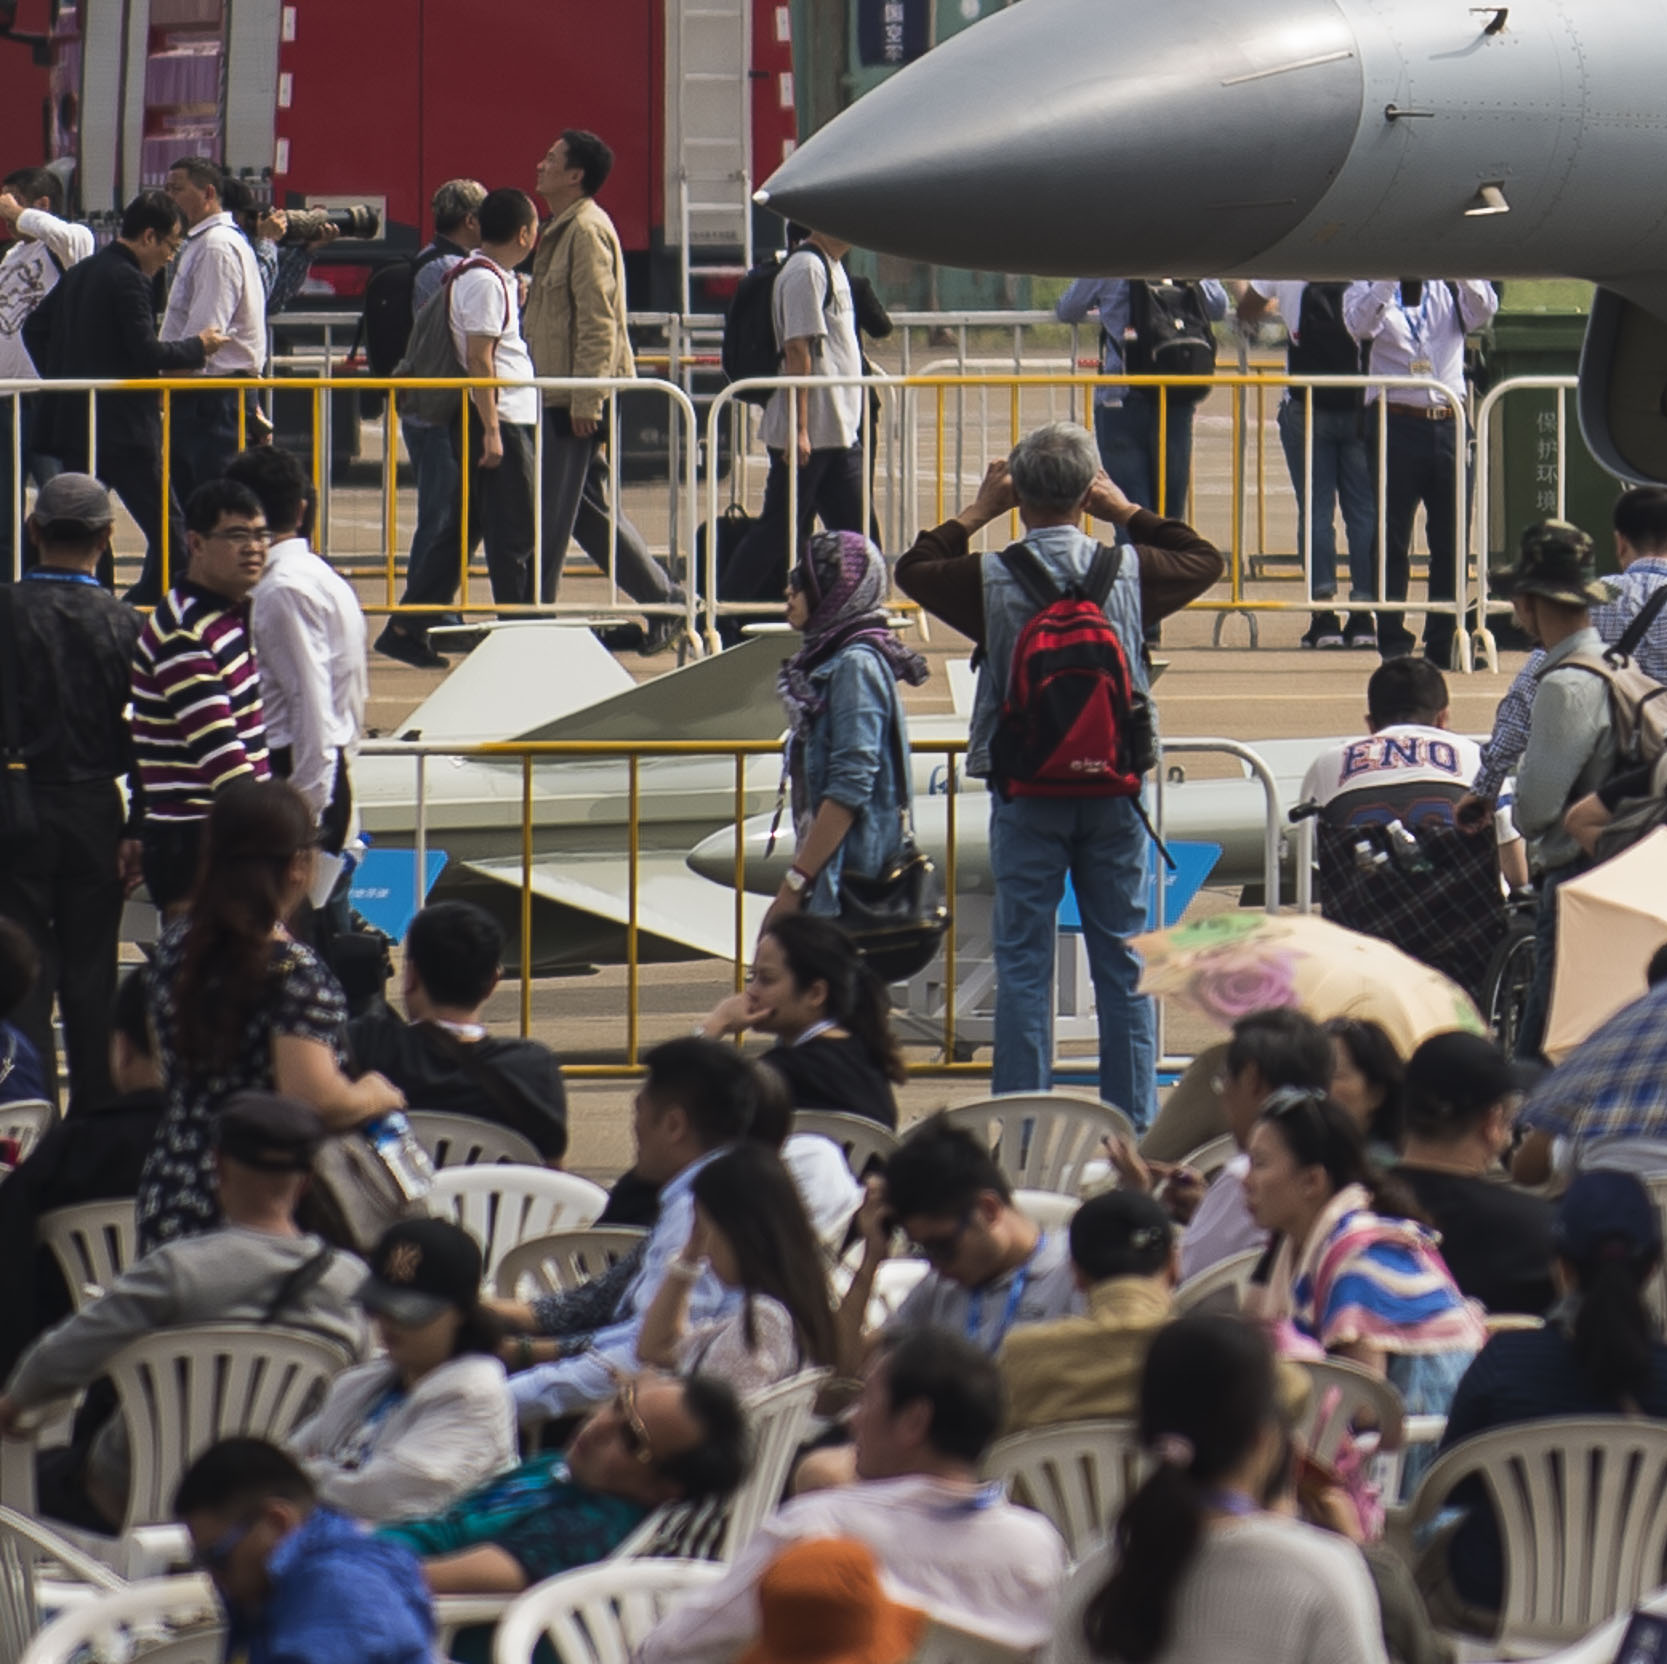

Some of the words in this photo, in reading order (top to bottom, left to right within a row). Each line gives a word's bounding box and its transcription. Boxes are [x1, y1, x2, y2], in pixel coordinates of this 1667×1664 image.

[1536, 411, 1558, 511] 保护环境
[1338, 735, 1462, 786] ENO
